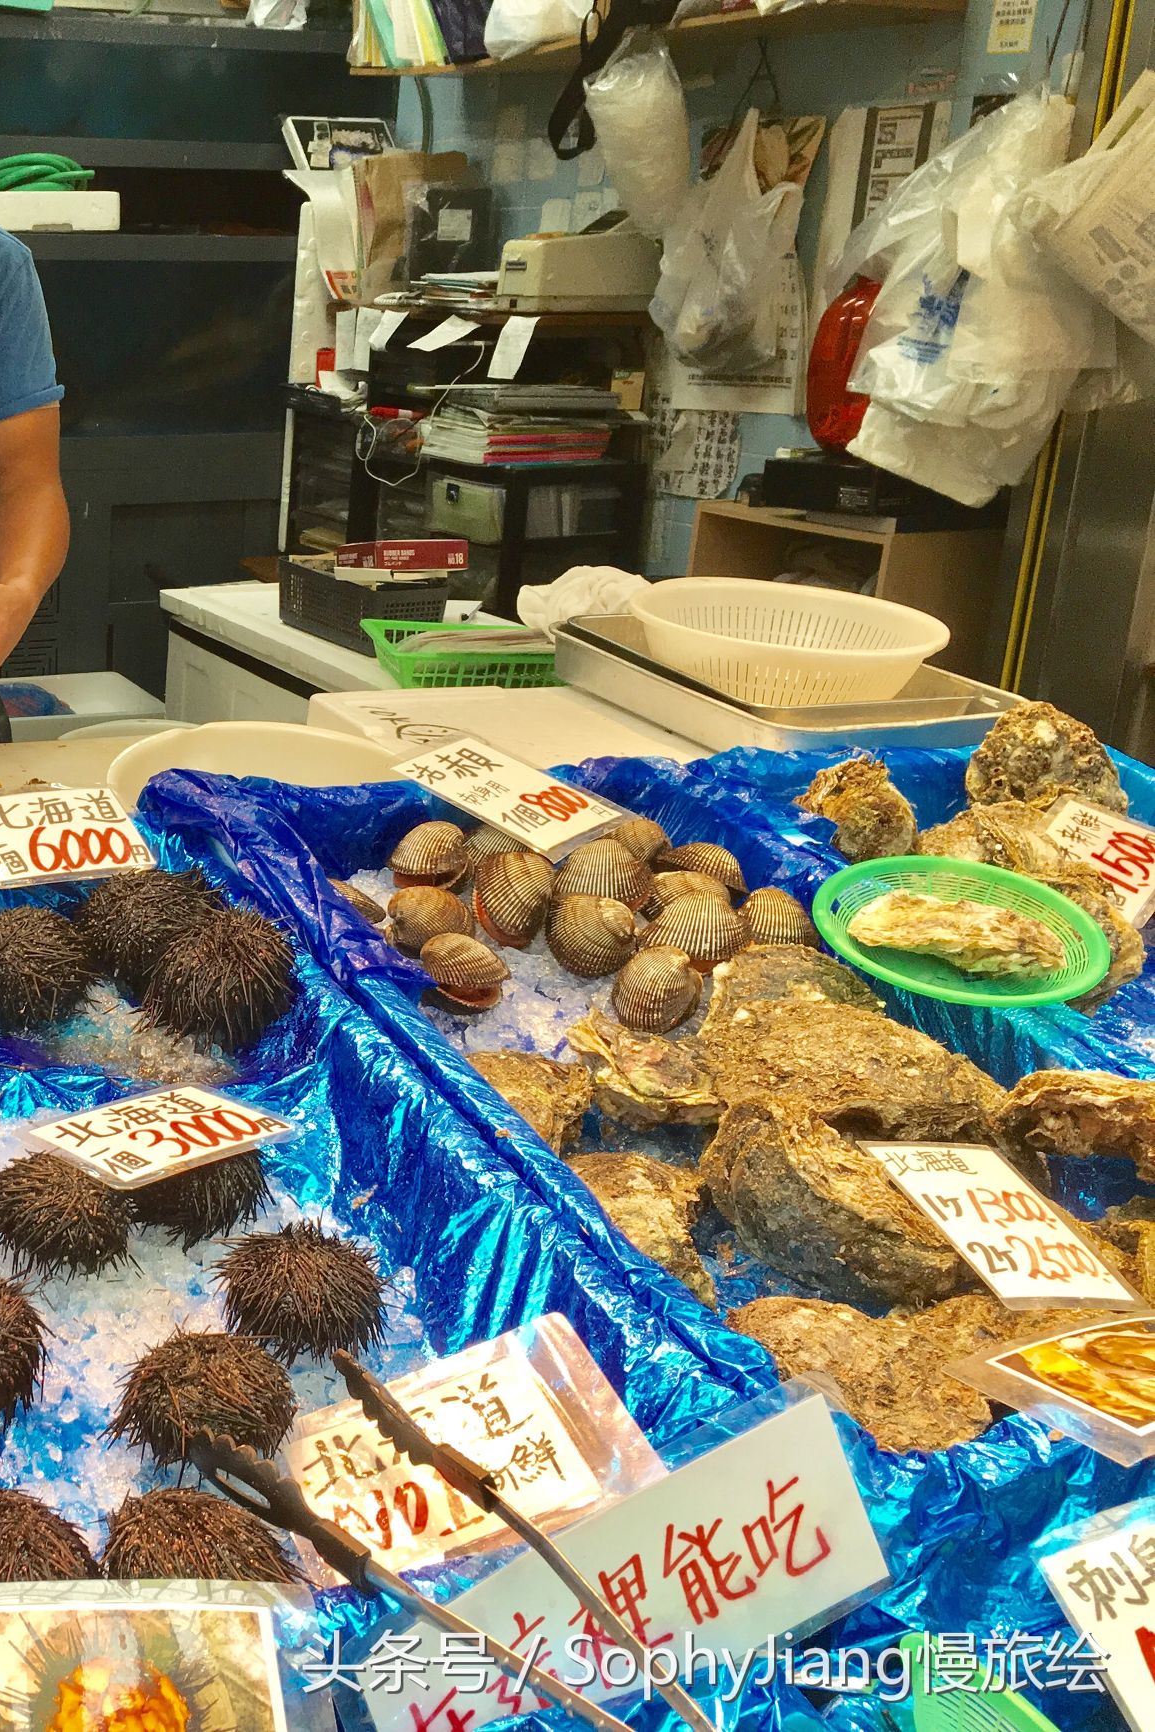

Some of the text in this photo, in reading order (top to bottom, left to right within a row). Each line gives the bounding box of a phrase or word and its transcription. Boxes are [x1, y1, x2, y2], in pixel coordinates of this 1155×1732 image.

[55, 1092, 223, 1147] 北海道
[884, 1149, 978, 1176] 北海道
[302, 1373, 535, 1499] 北道
